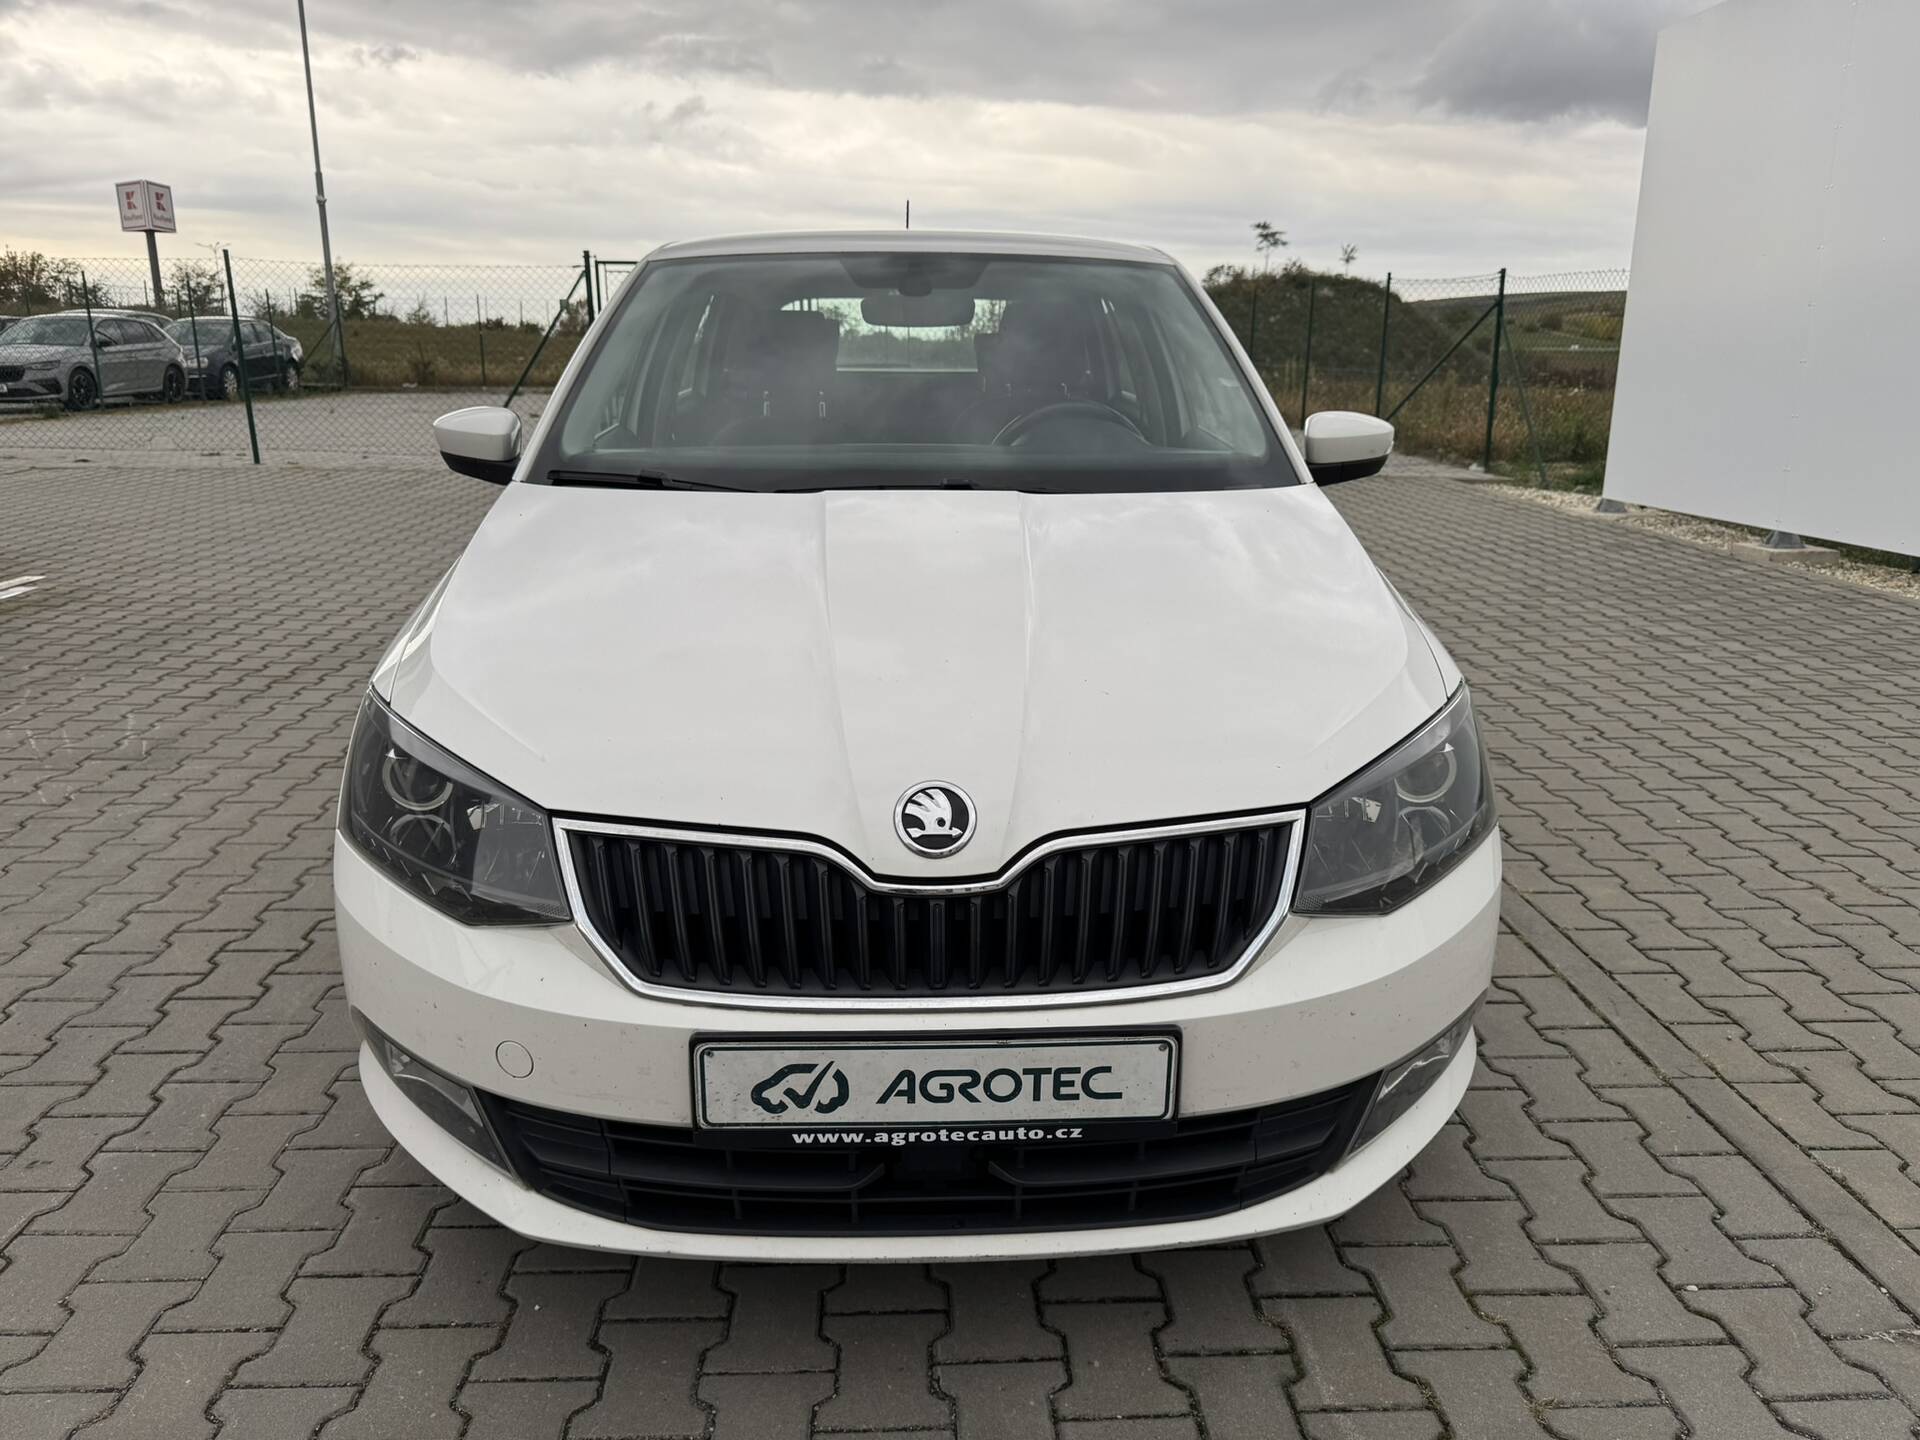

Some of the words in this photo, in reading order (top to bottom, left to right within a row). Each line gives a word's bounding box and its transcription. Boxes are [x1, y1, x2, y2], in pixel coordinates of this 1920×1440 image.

[125, 190, 137, 210] K
[155, 191, 166, 212] K
[875, 1066, 1123, 1104] AGROTEC
[792, 1127, 1084, 1146] www.agrotecauto.cz
